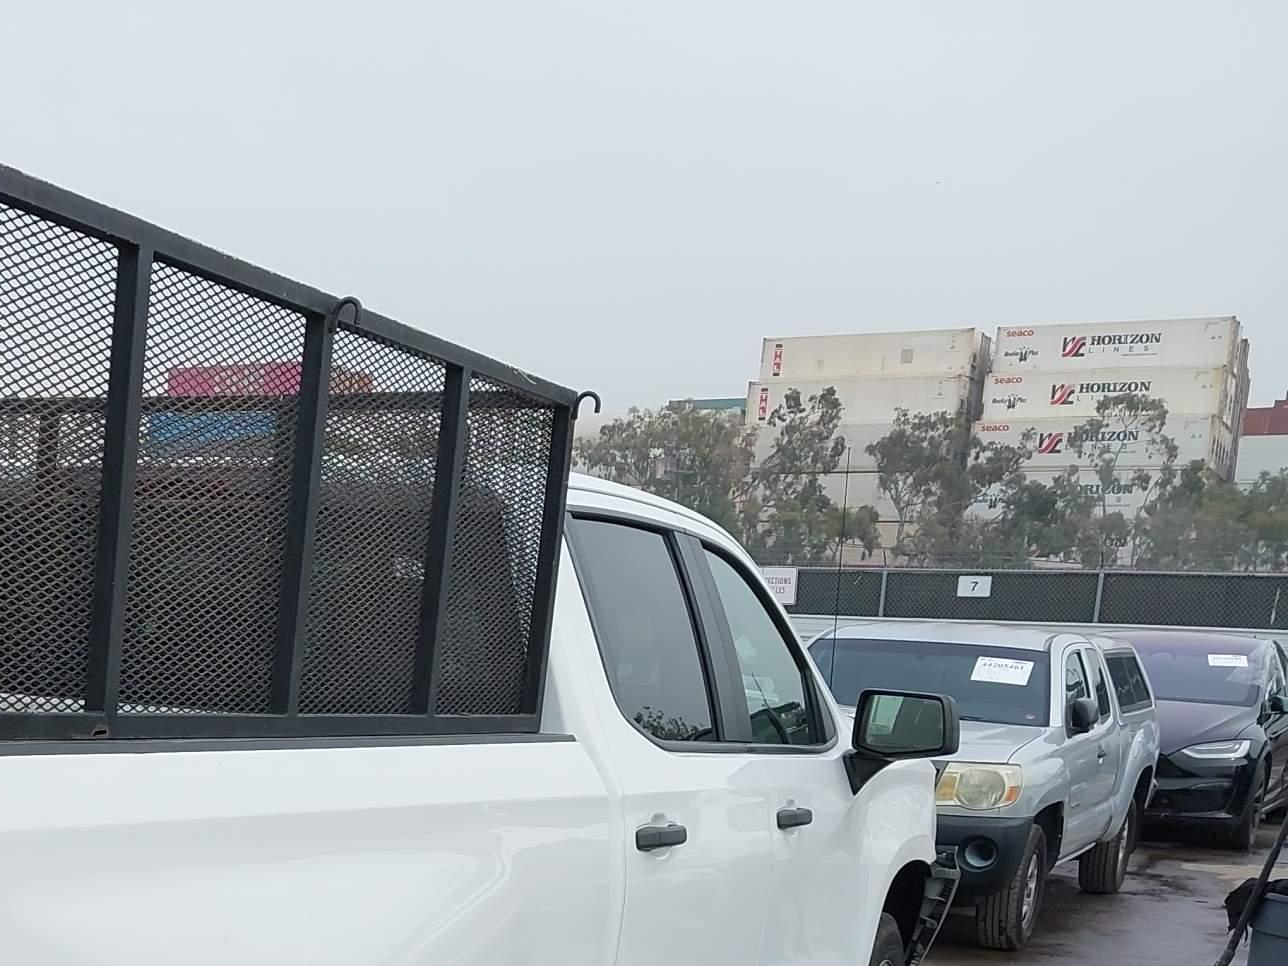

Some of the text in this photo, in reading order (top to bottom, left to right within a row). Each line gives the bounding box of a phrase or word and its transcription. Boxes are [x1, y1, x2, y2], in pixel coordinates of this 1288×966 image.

[1006, 329, 1034, 337] seaco
[1090, 333, 1162, 346] HORIZON
[1088, 345, 1150, 353] LINES
[994, 376, 1023, 384] seaco
[1079, 381, 1152, 394] HORIZON
[980, 424, 1010, 432] seaco
[970, 581, 980, 592] 7
